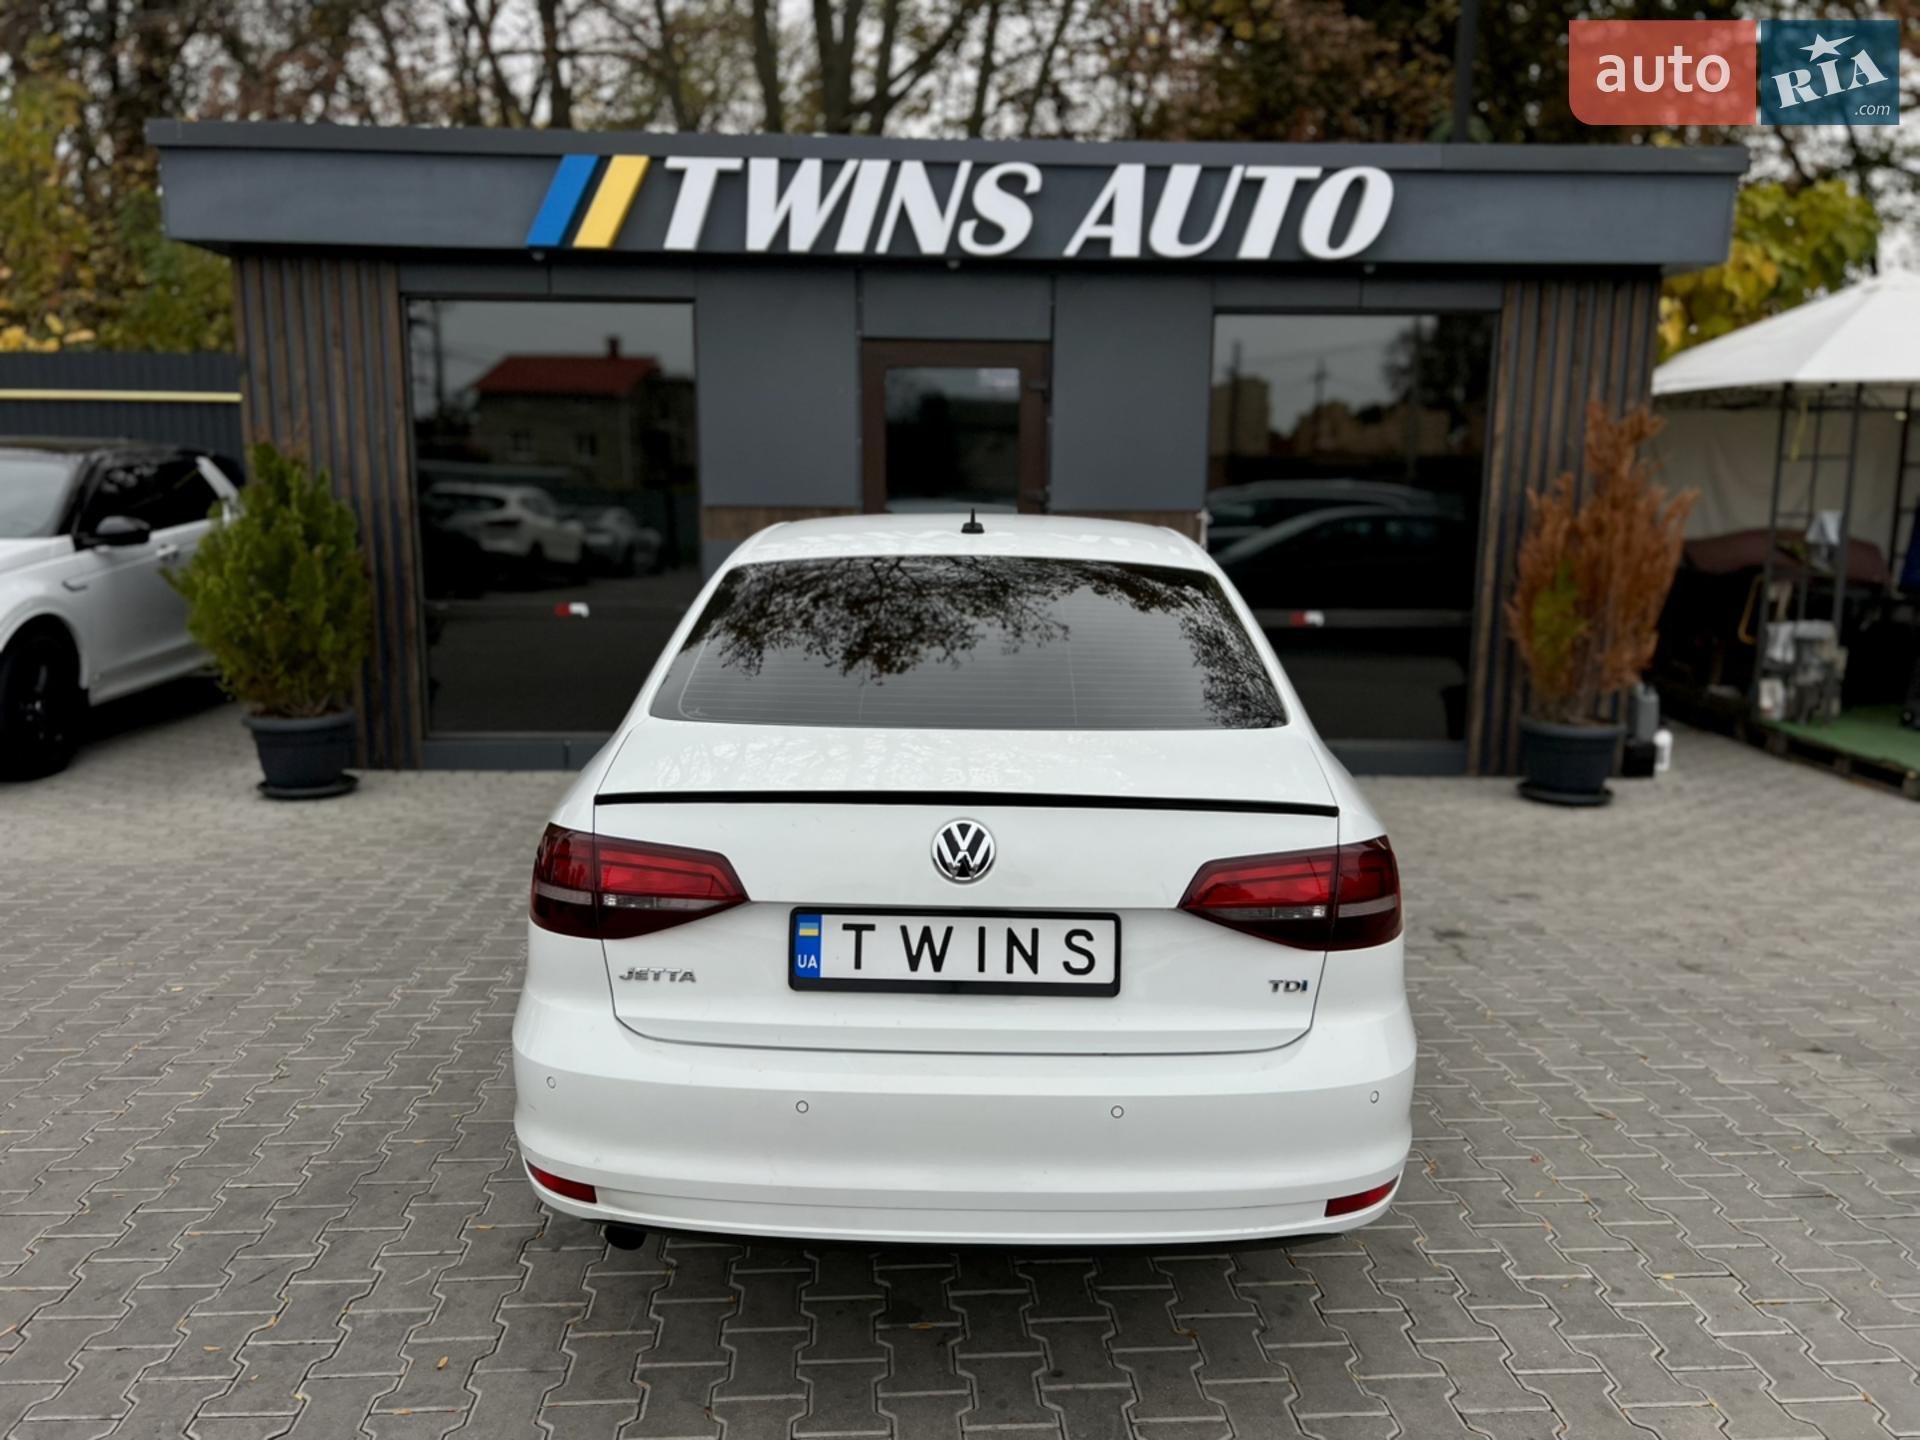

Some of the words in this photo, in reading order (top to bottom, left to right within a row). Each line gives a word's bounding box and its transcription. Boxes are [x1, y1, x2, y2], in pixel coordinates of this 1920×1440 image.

[663, 157, 1043, 256] TWINS
[1062, 163, 1394, 260] AUTO
[797, 953, 819, 970] UA
[619, 967, 697, 983] JETTA
[1268, 979, 1309, 993] TDI
